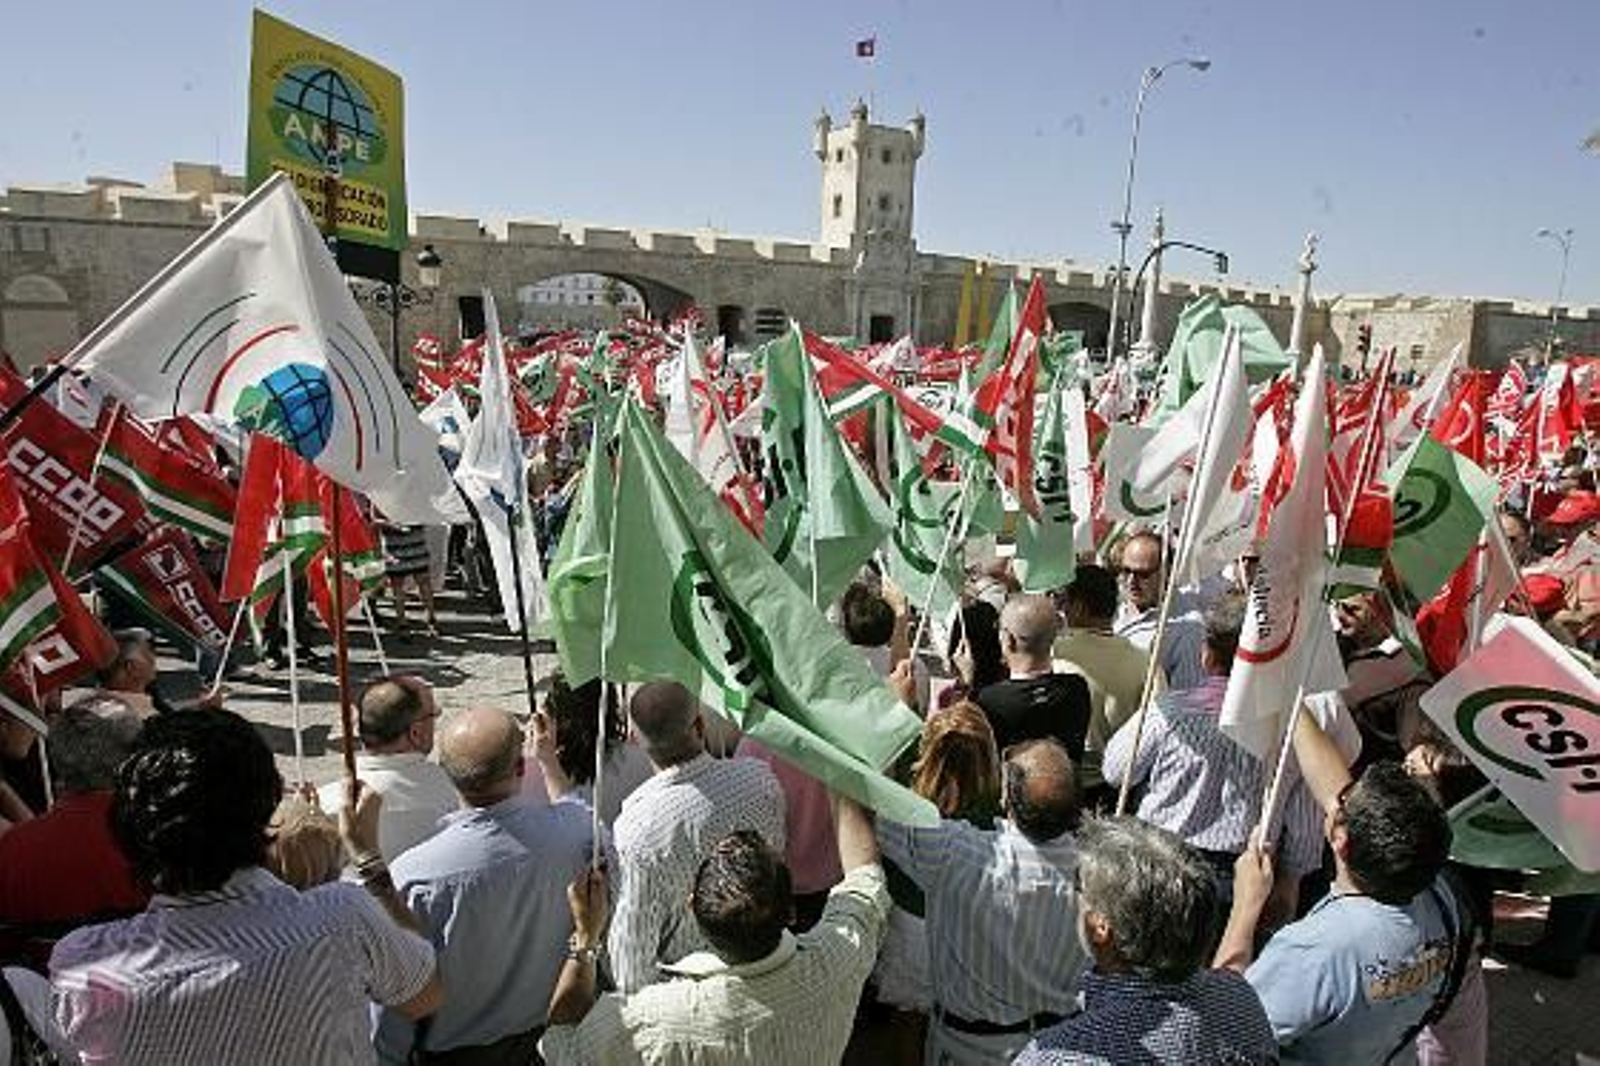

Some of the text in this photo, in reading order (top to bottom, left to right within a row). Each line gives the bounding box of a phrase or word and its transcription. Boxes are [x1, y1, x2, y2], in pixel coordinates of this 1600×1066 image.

[284, 112, 369, 160] ANPE
[7, 437, 125, 532] CCOO
[175, 581, 227, 648] CCOO
